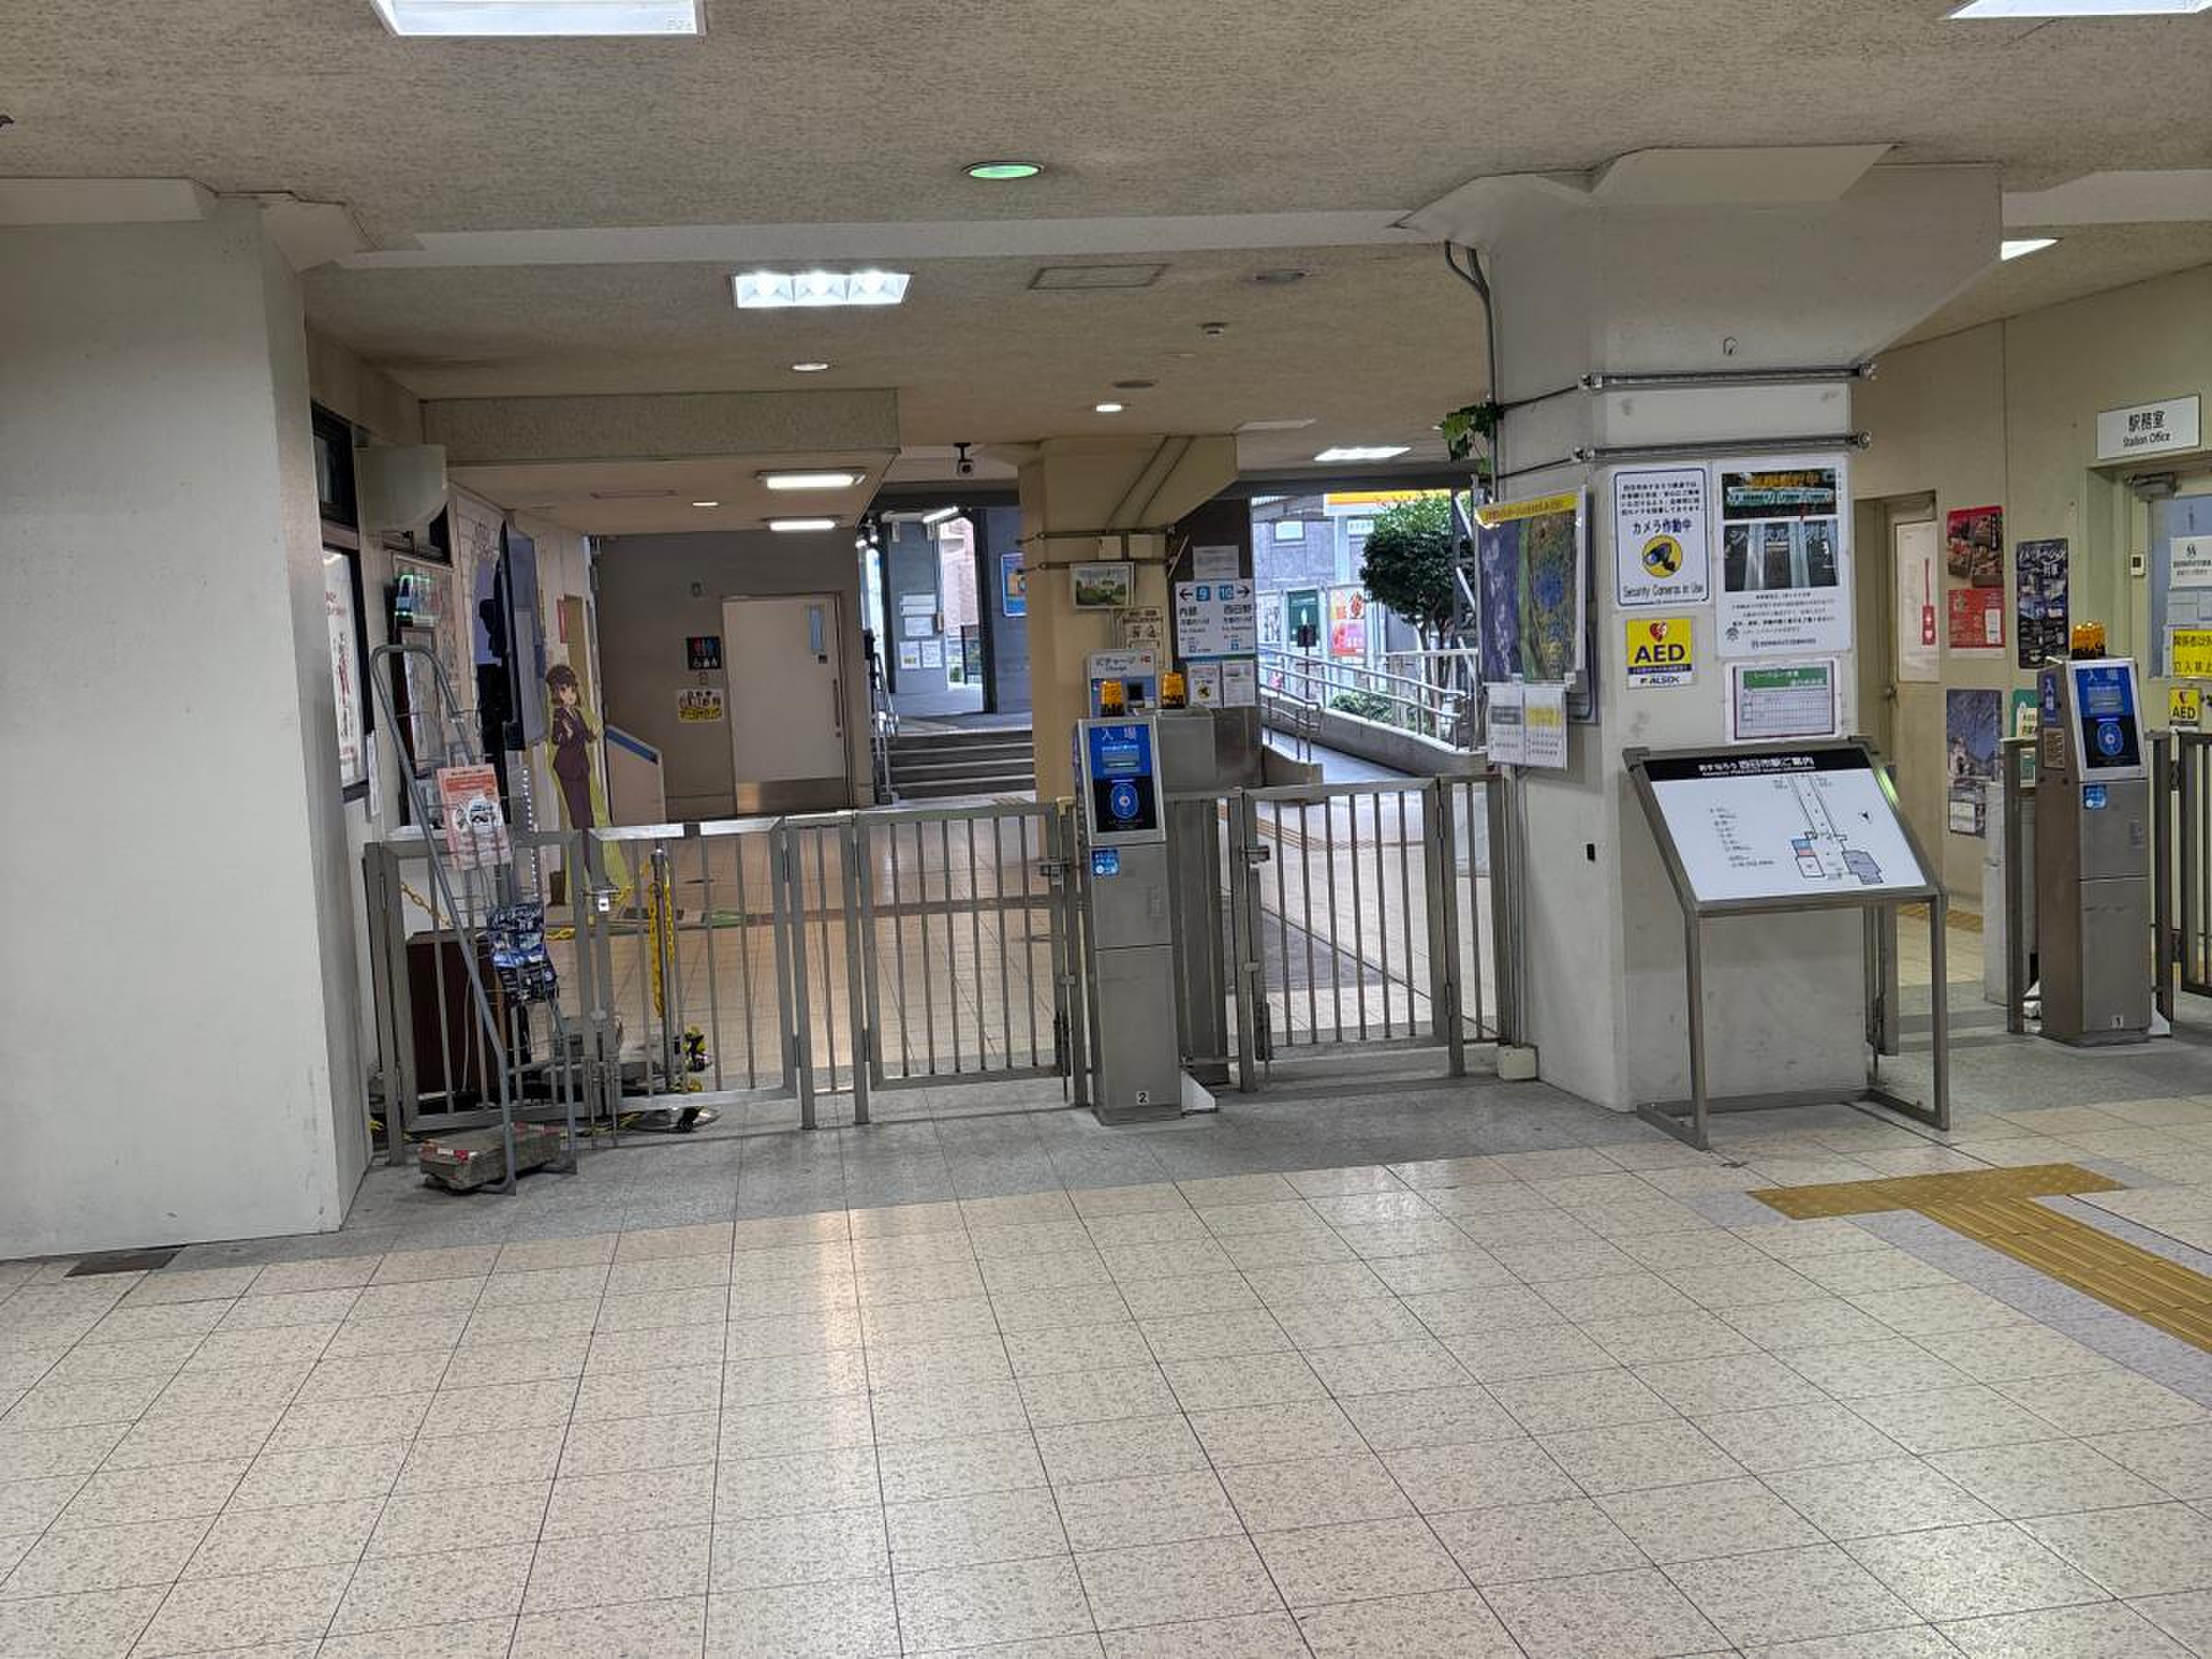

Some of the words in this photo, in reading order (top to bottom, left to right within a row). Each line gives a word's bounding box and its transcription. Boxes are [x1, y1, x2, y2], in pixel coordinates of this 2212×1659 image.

[2129, 411, 2165, 431] 駅務室
[2124, 435, 2147, 447] Station
[2149, 430, 2170, 442] Office
[1632, 518, 1692, 535] カメラ作動中
[1634, 643, 1686, 664] AED
[2172, 707, 2195, 719] AED
[1138, 1091, 1147, 1103] 2
